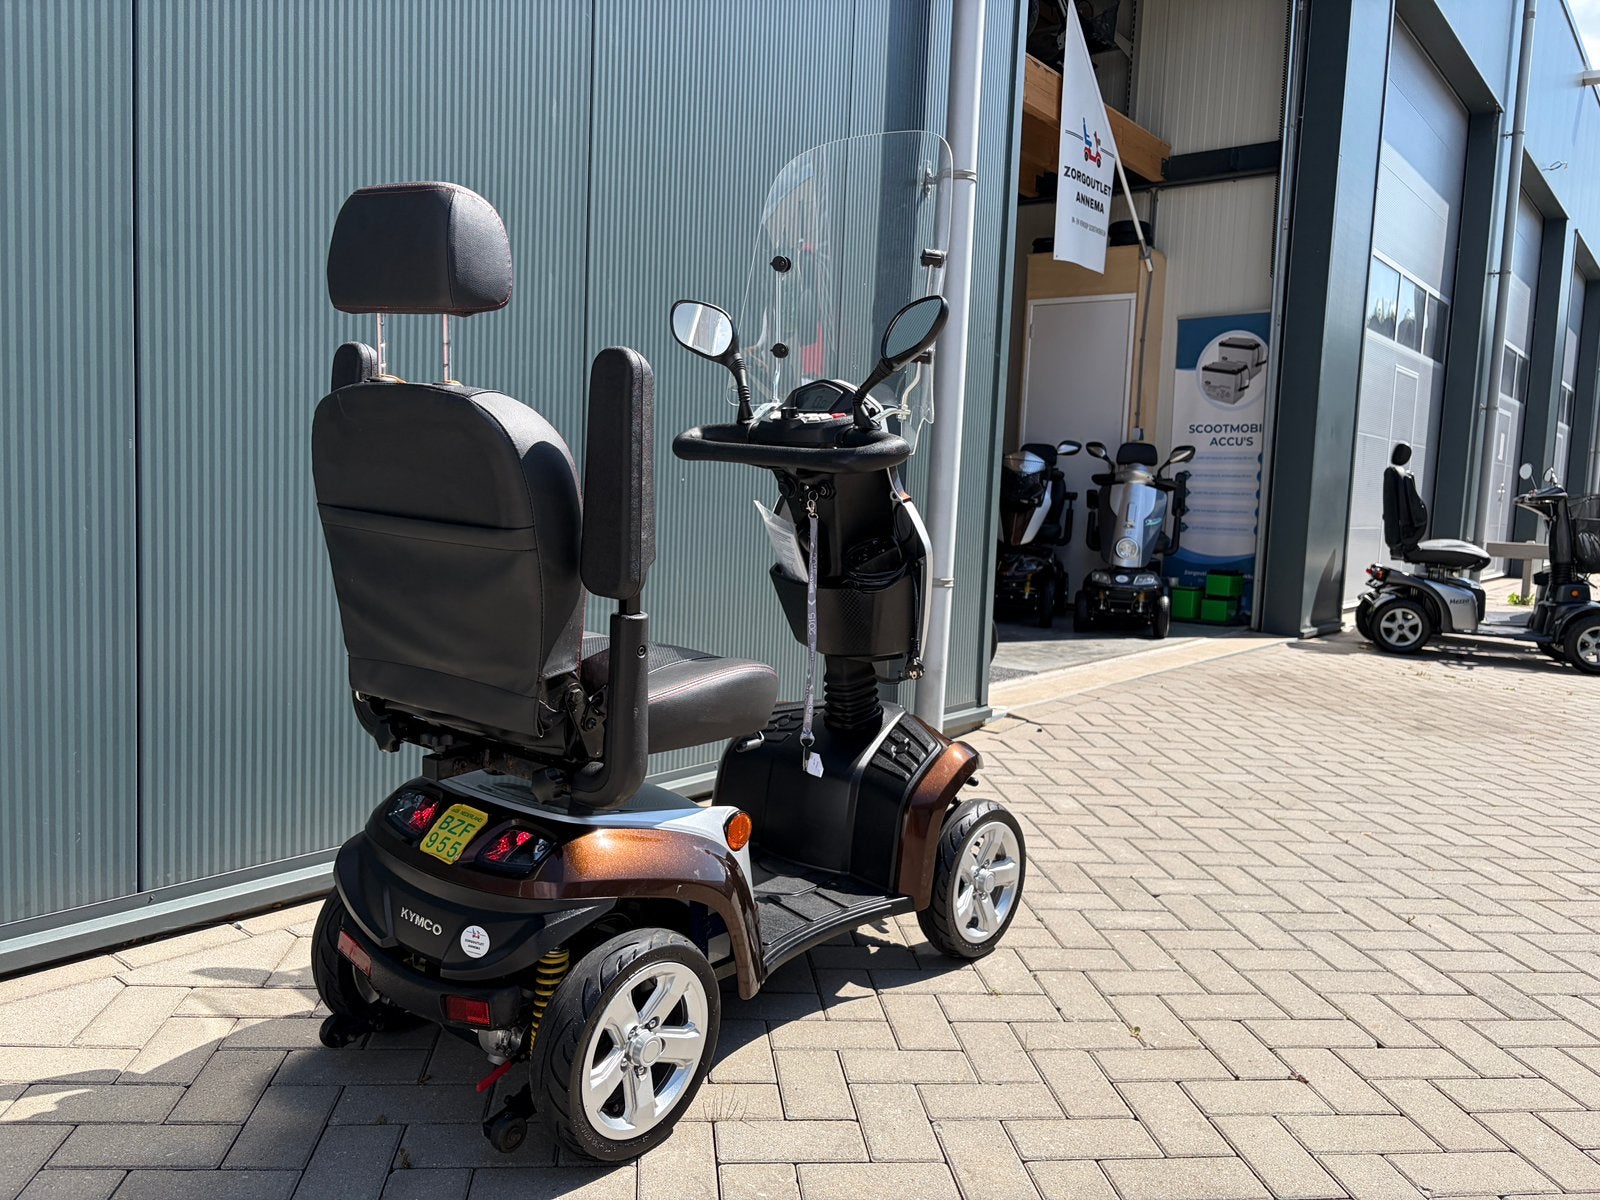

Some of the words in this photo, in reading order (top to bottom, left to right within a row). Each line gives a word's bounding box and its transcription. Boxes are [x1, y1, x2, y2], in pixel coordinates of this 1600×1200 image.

[1064, 166, 1112, 197] ZORGOUTLET
[1075, 191, 1104, 214] ANNEMA
[1209, 436, 1254, 446] ACCU'S
[438, 815, 476, 837] BZF
[425, 832, 462, 858] 955
[400, 906, 442, 936] KYMCO
